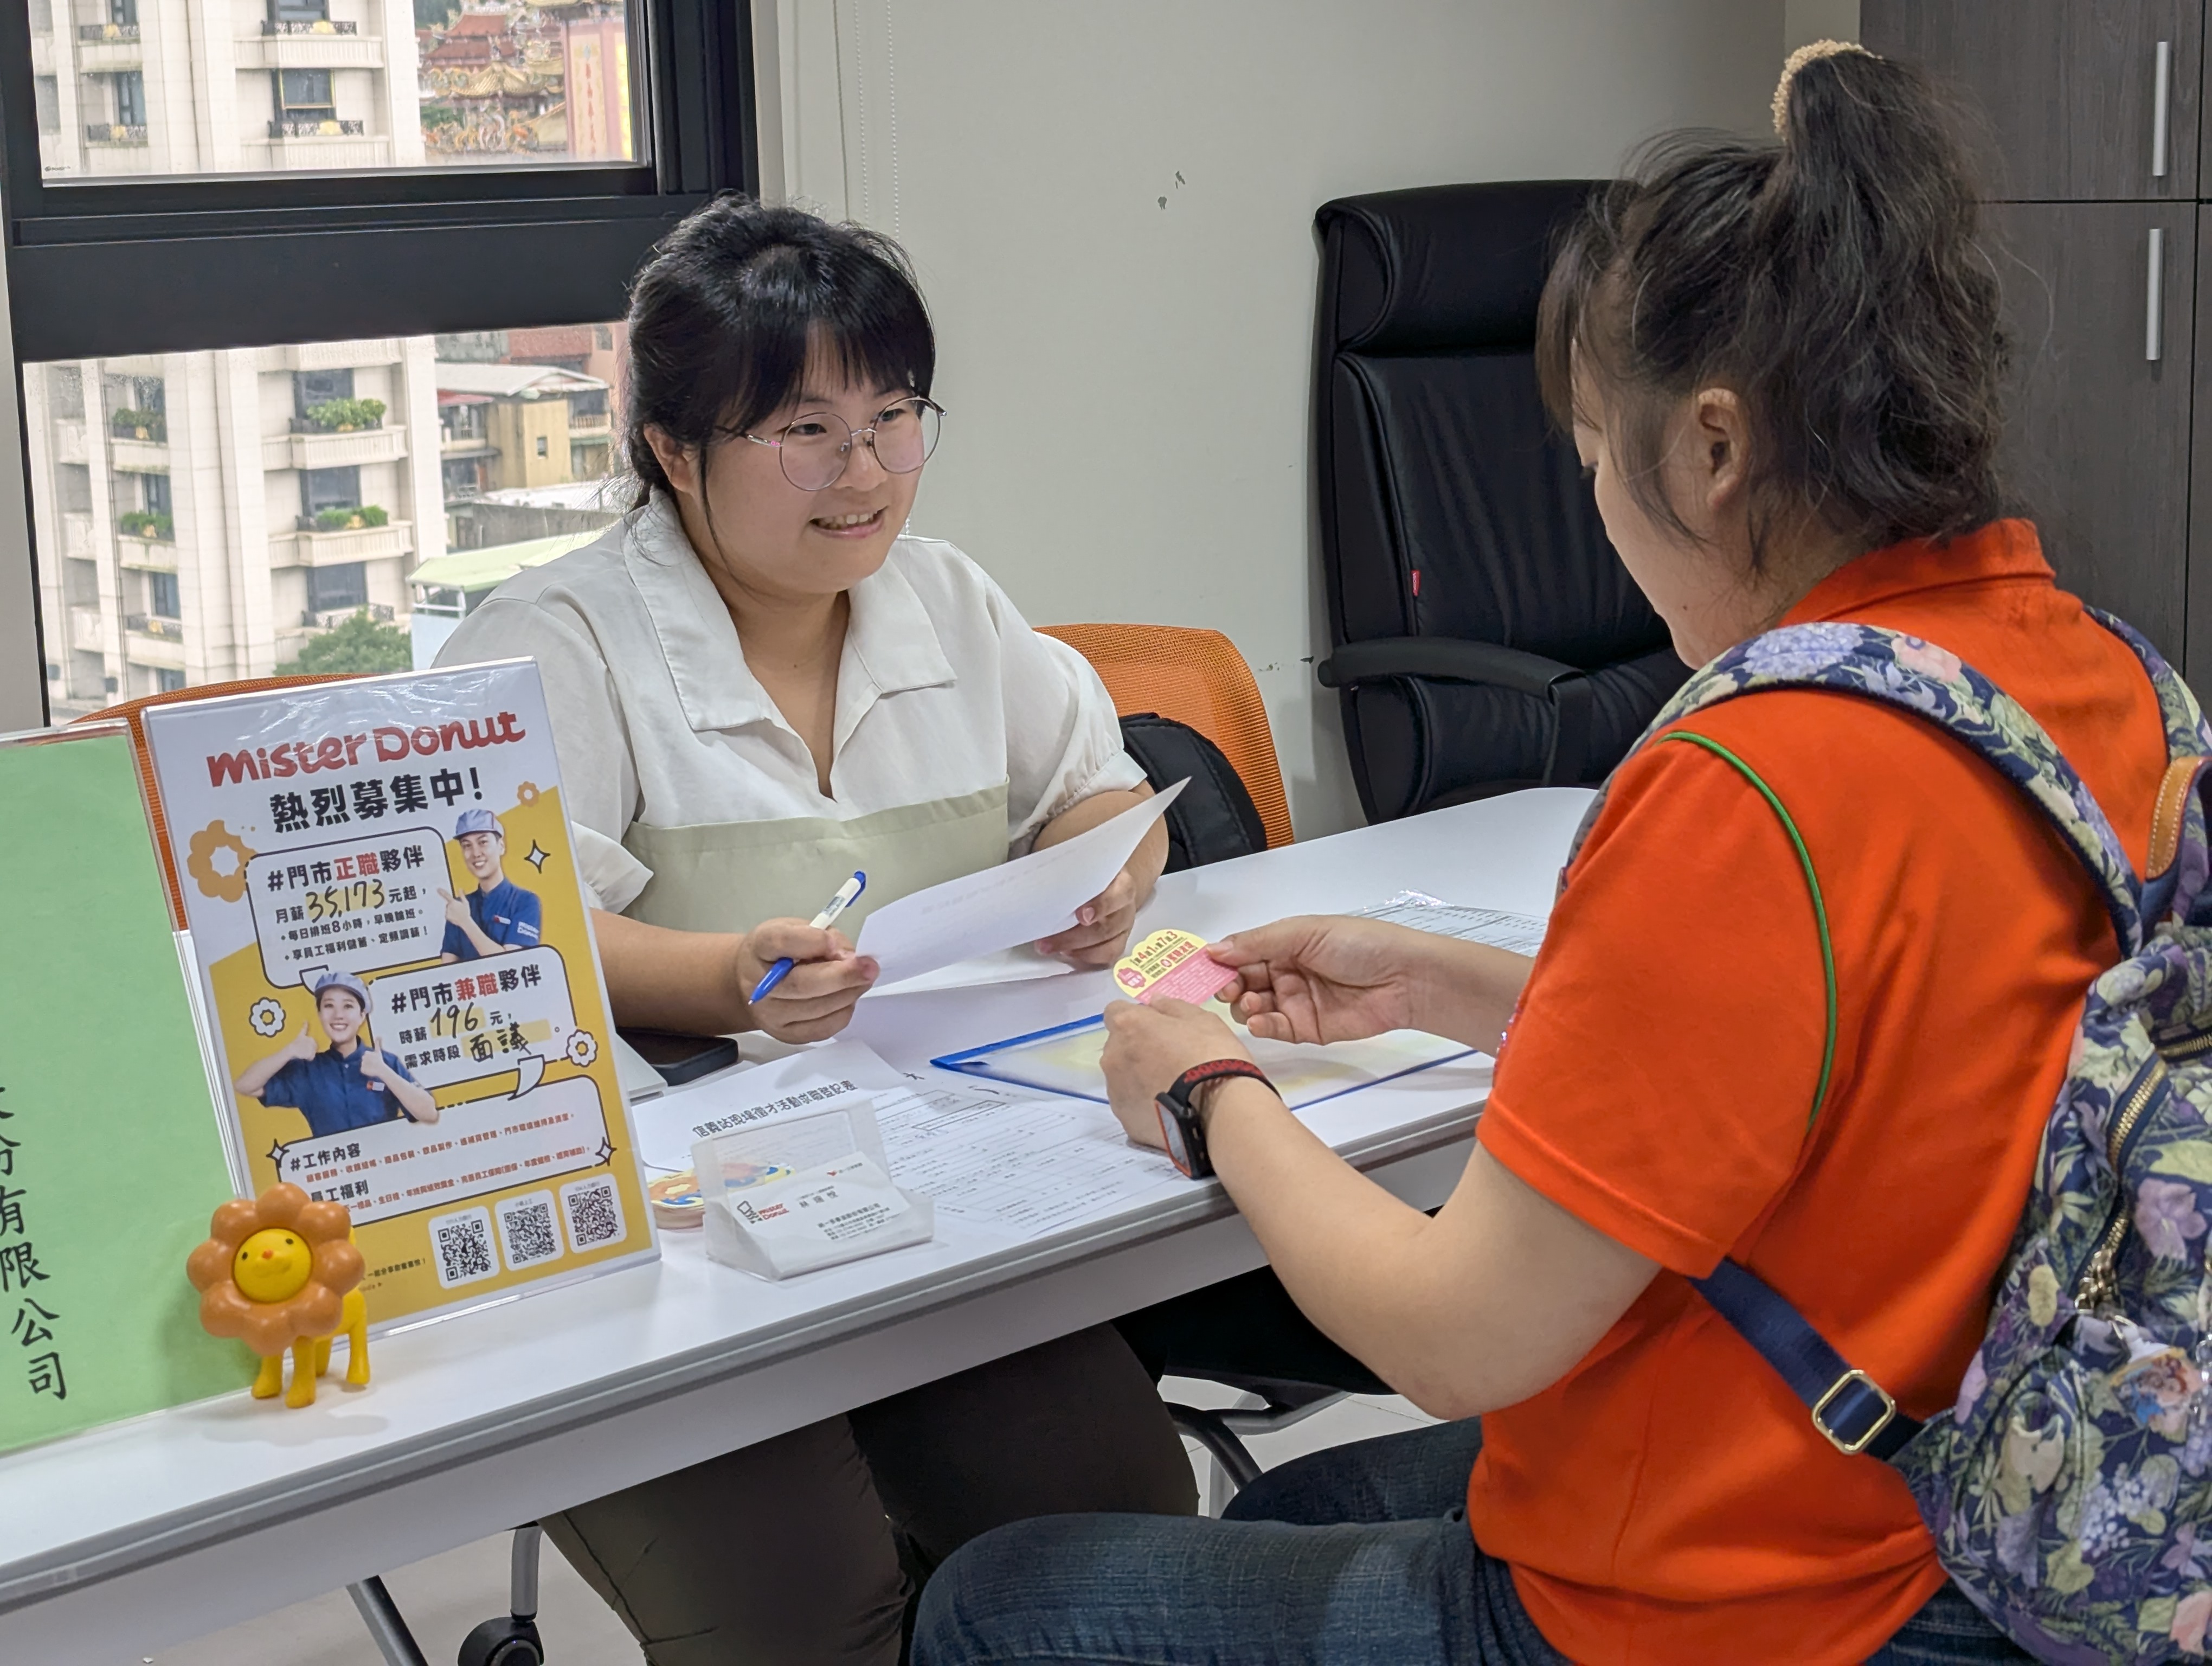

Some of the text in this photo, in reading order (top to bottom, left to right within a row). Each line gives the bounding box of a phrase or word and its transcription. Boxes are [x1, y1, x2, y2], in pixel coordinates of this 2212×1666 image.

[372, 712, 526, 763] Donut
[268, 845, 425, 891] #門市正職夥伴
[306, 879, 385, 923] 35,173
[391, 964, 541, 1014] #門市兼職夥伴
[399, 1027, 427, 1044] 時薪
[430, 1002, 478, 1038] 196
[404, 1045, 461, 1069] 需求時段
[0, 1086, 67, 1400] 有限公司
